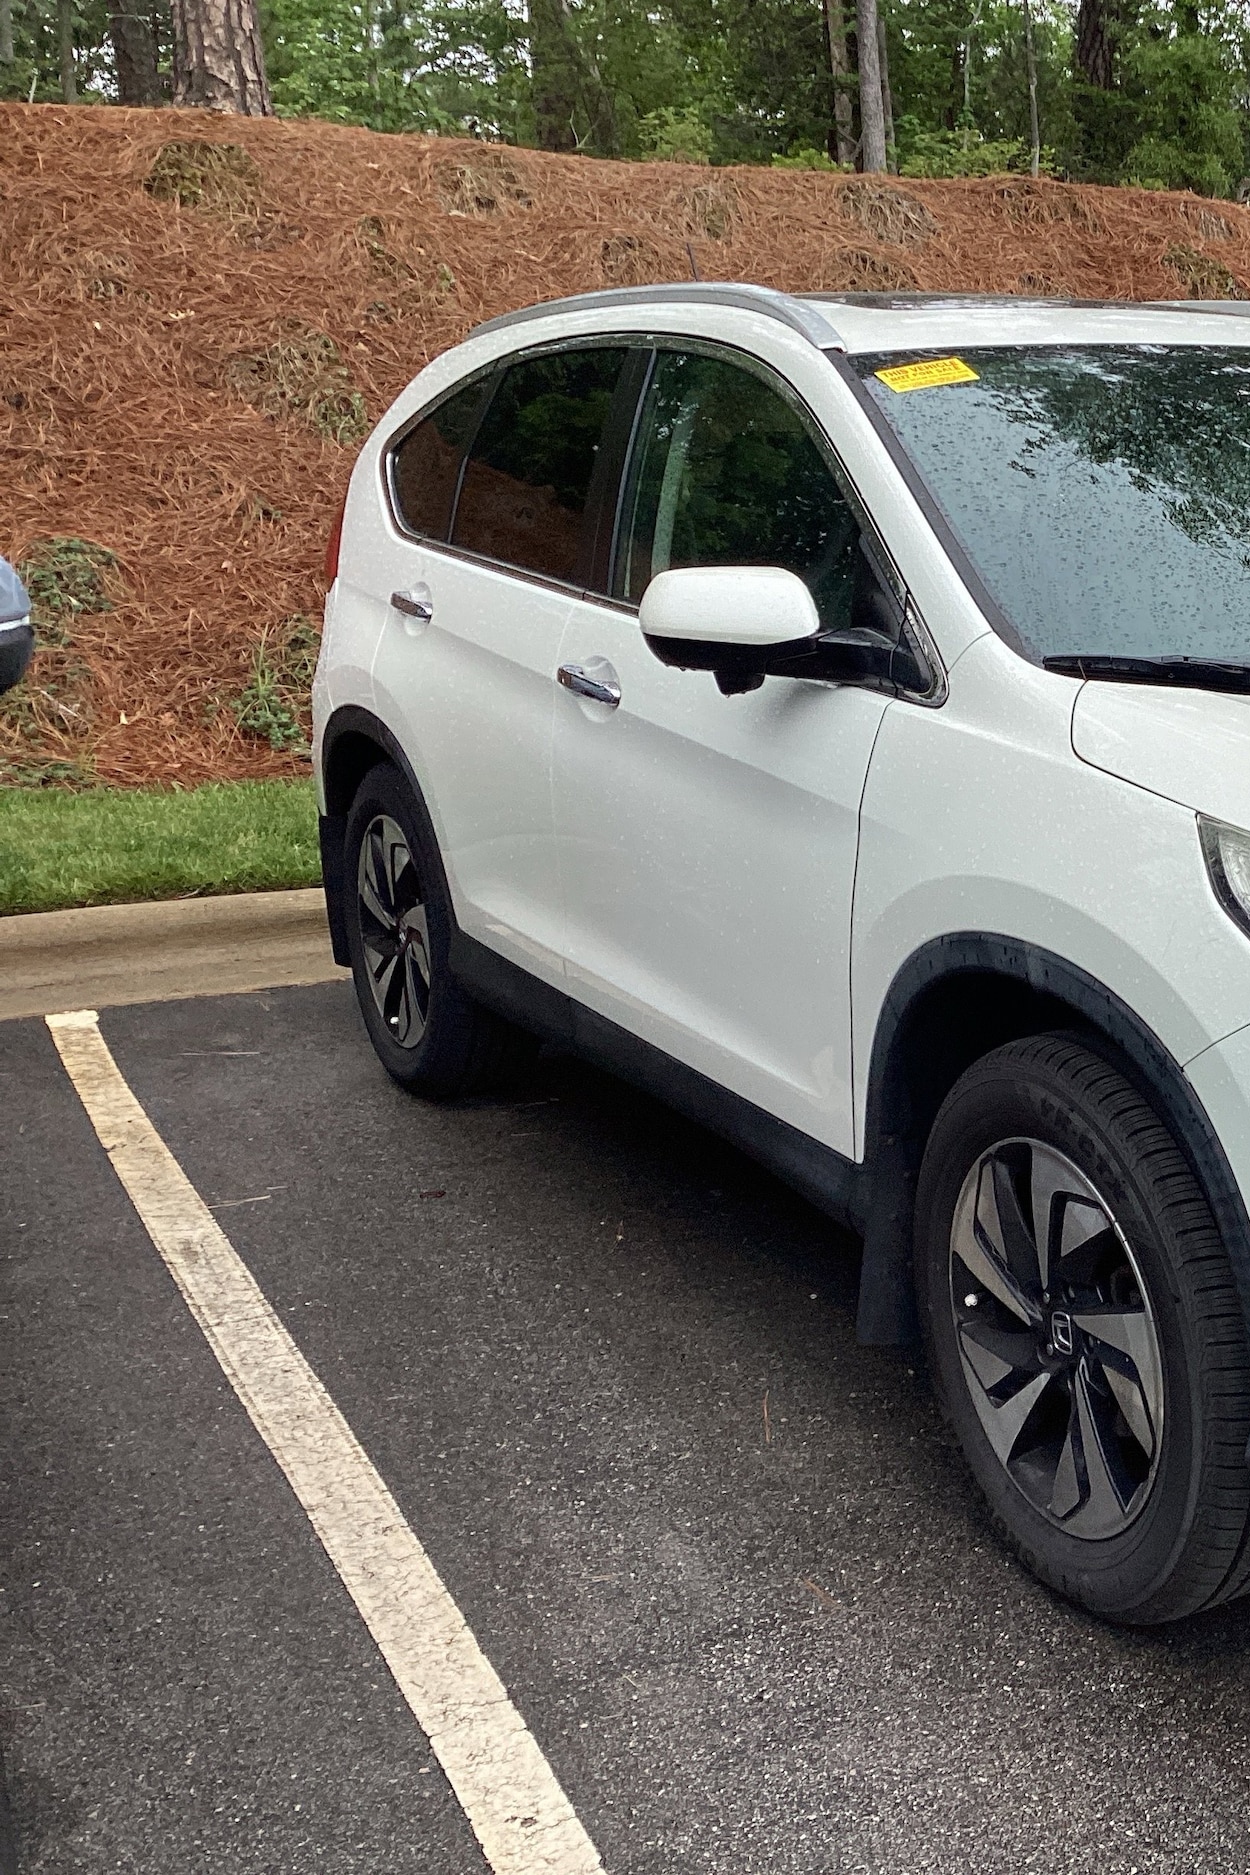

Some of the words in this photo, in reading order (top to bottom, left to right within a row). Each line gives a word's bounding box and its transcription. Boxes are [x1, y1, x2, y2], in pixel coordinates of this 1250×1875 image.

[882, 368, 909, 378] THIS
[910, 360, 958, 373] VEHICLE
[912, 370, 934, 378] FOR
[936, 364, 959, 373] SALE
